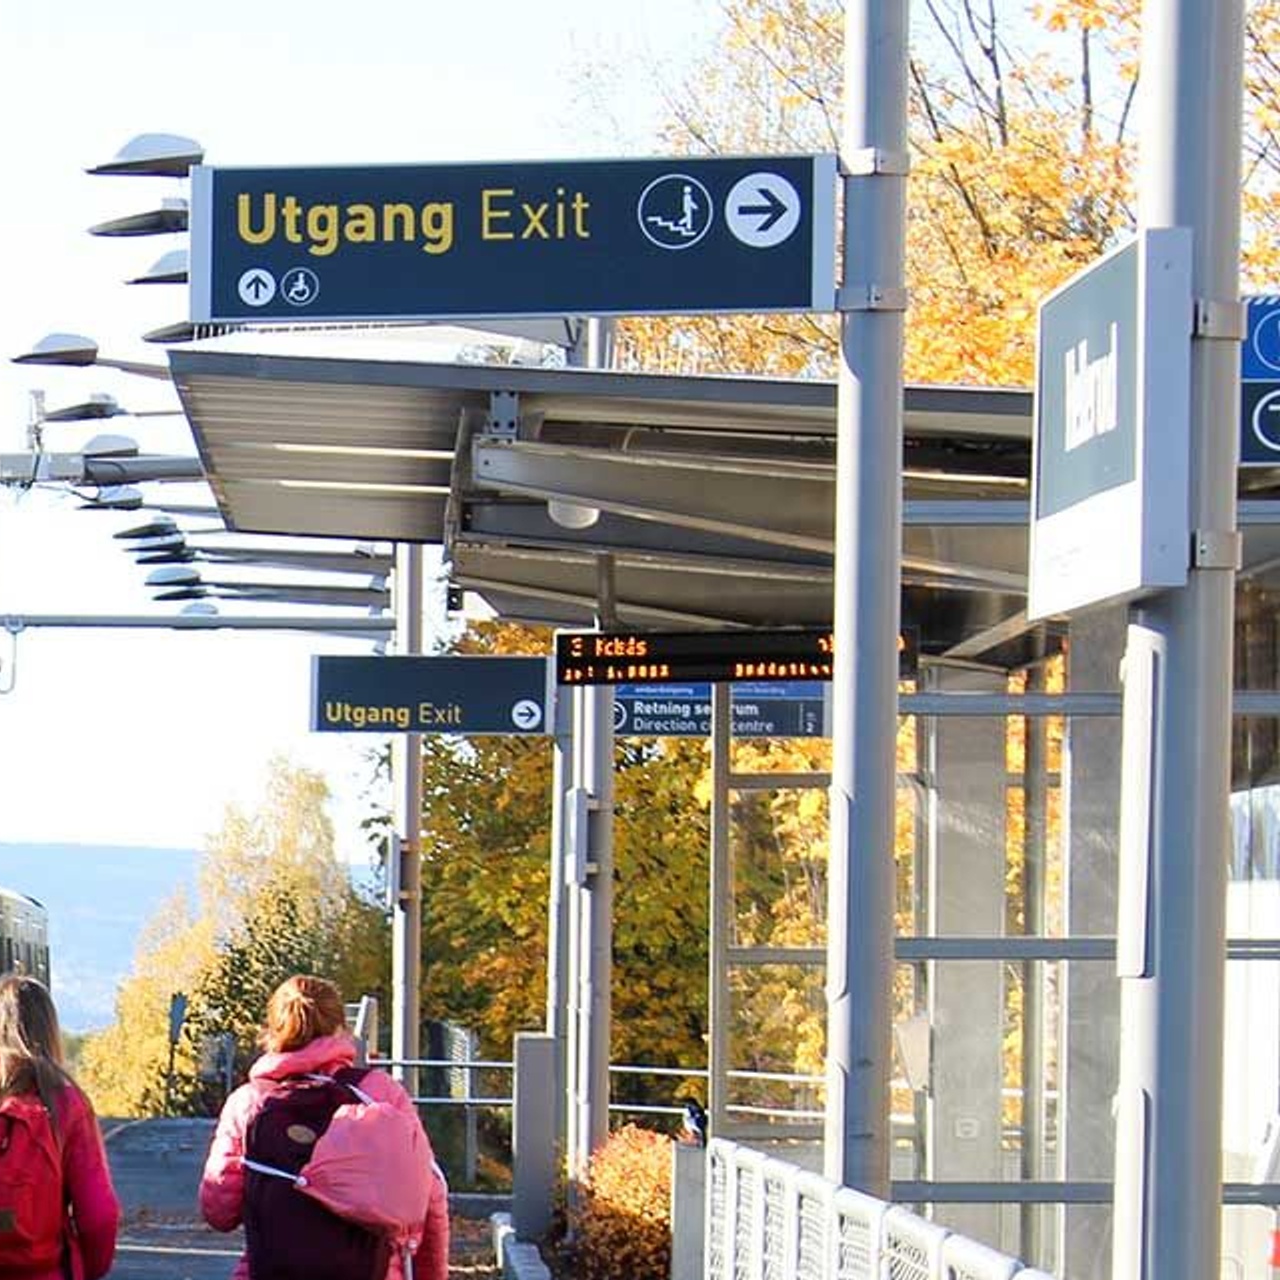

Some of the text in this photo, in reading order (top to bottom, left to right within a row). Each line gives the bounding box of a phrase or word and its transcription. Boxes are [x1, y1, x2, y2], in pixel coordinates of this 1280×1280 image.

[238, 188, 589, 256] Utgang Exit
[325, 702, 462, 728] Utgang Exit
[634, 701, 759, 717] Retning serum
[634, 717, 697, 731] Direction
